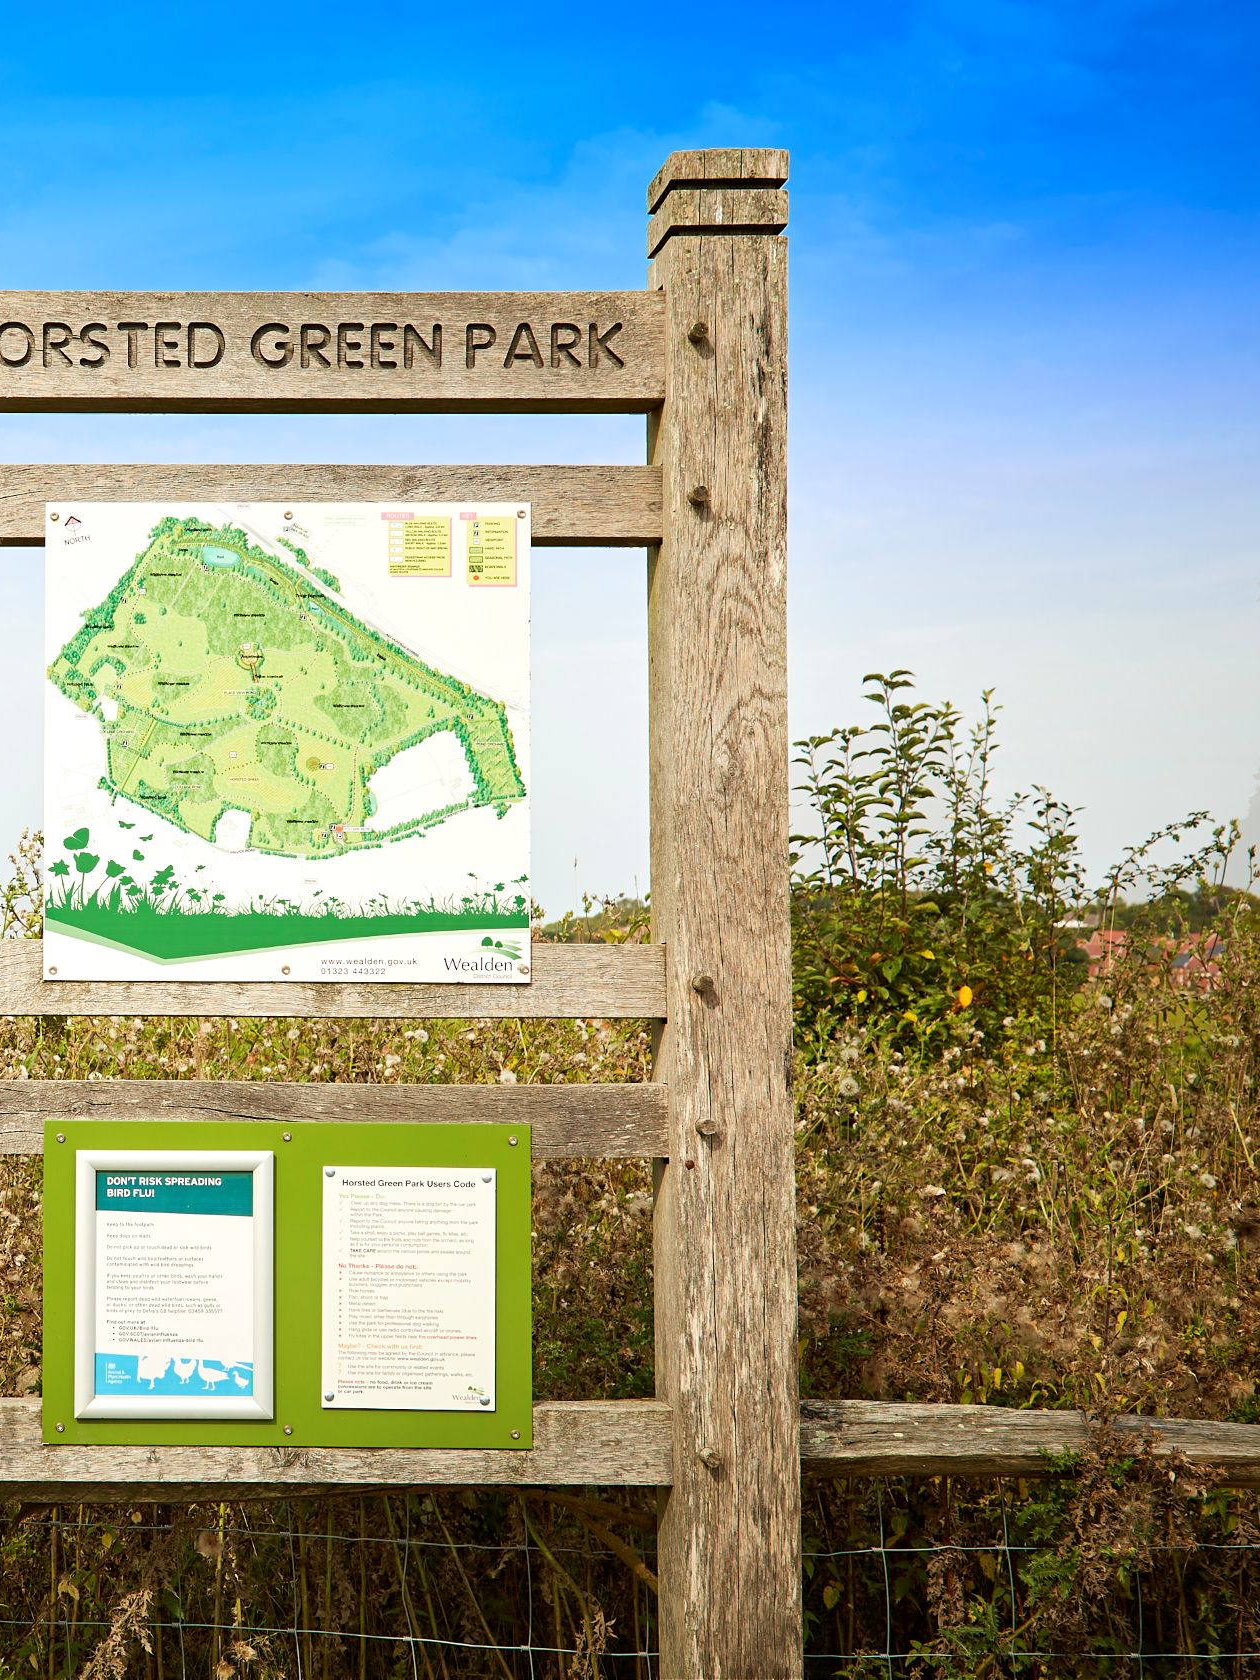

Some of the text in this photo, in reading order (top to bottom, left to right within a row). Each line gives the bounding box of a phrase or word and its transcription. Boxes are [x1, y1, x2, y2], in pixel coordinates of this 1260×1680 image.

[251, 322, 443, 370] GREEN
[466, 322, 625, 369] PARK
[64, 534, 90, 546] NORTH
[321, 958, 418, 966] www.wealden.gov.uk
[444, 957, 512, 971] Wealden
[107, 1177, 222, 1186] DON'T RISK SPREADING
[107, 1189, 155, 1197] BIRD FLU!
